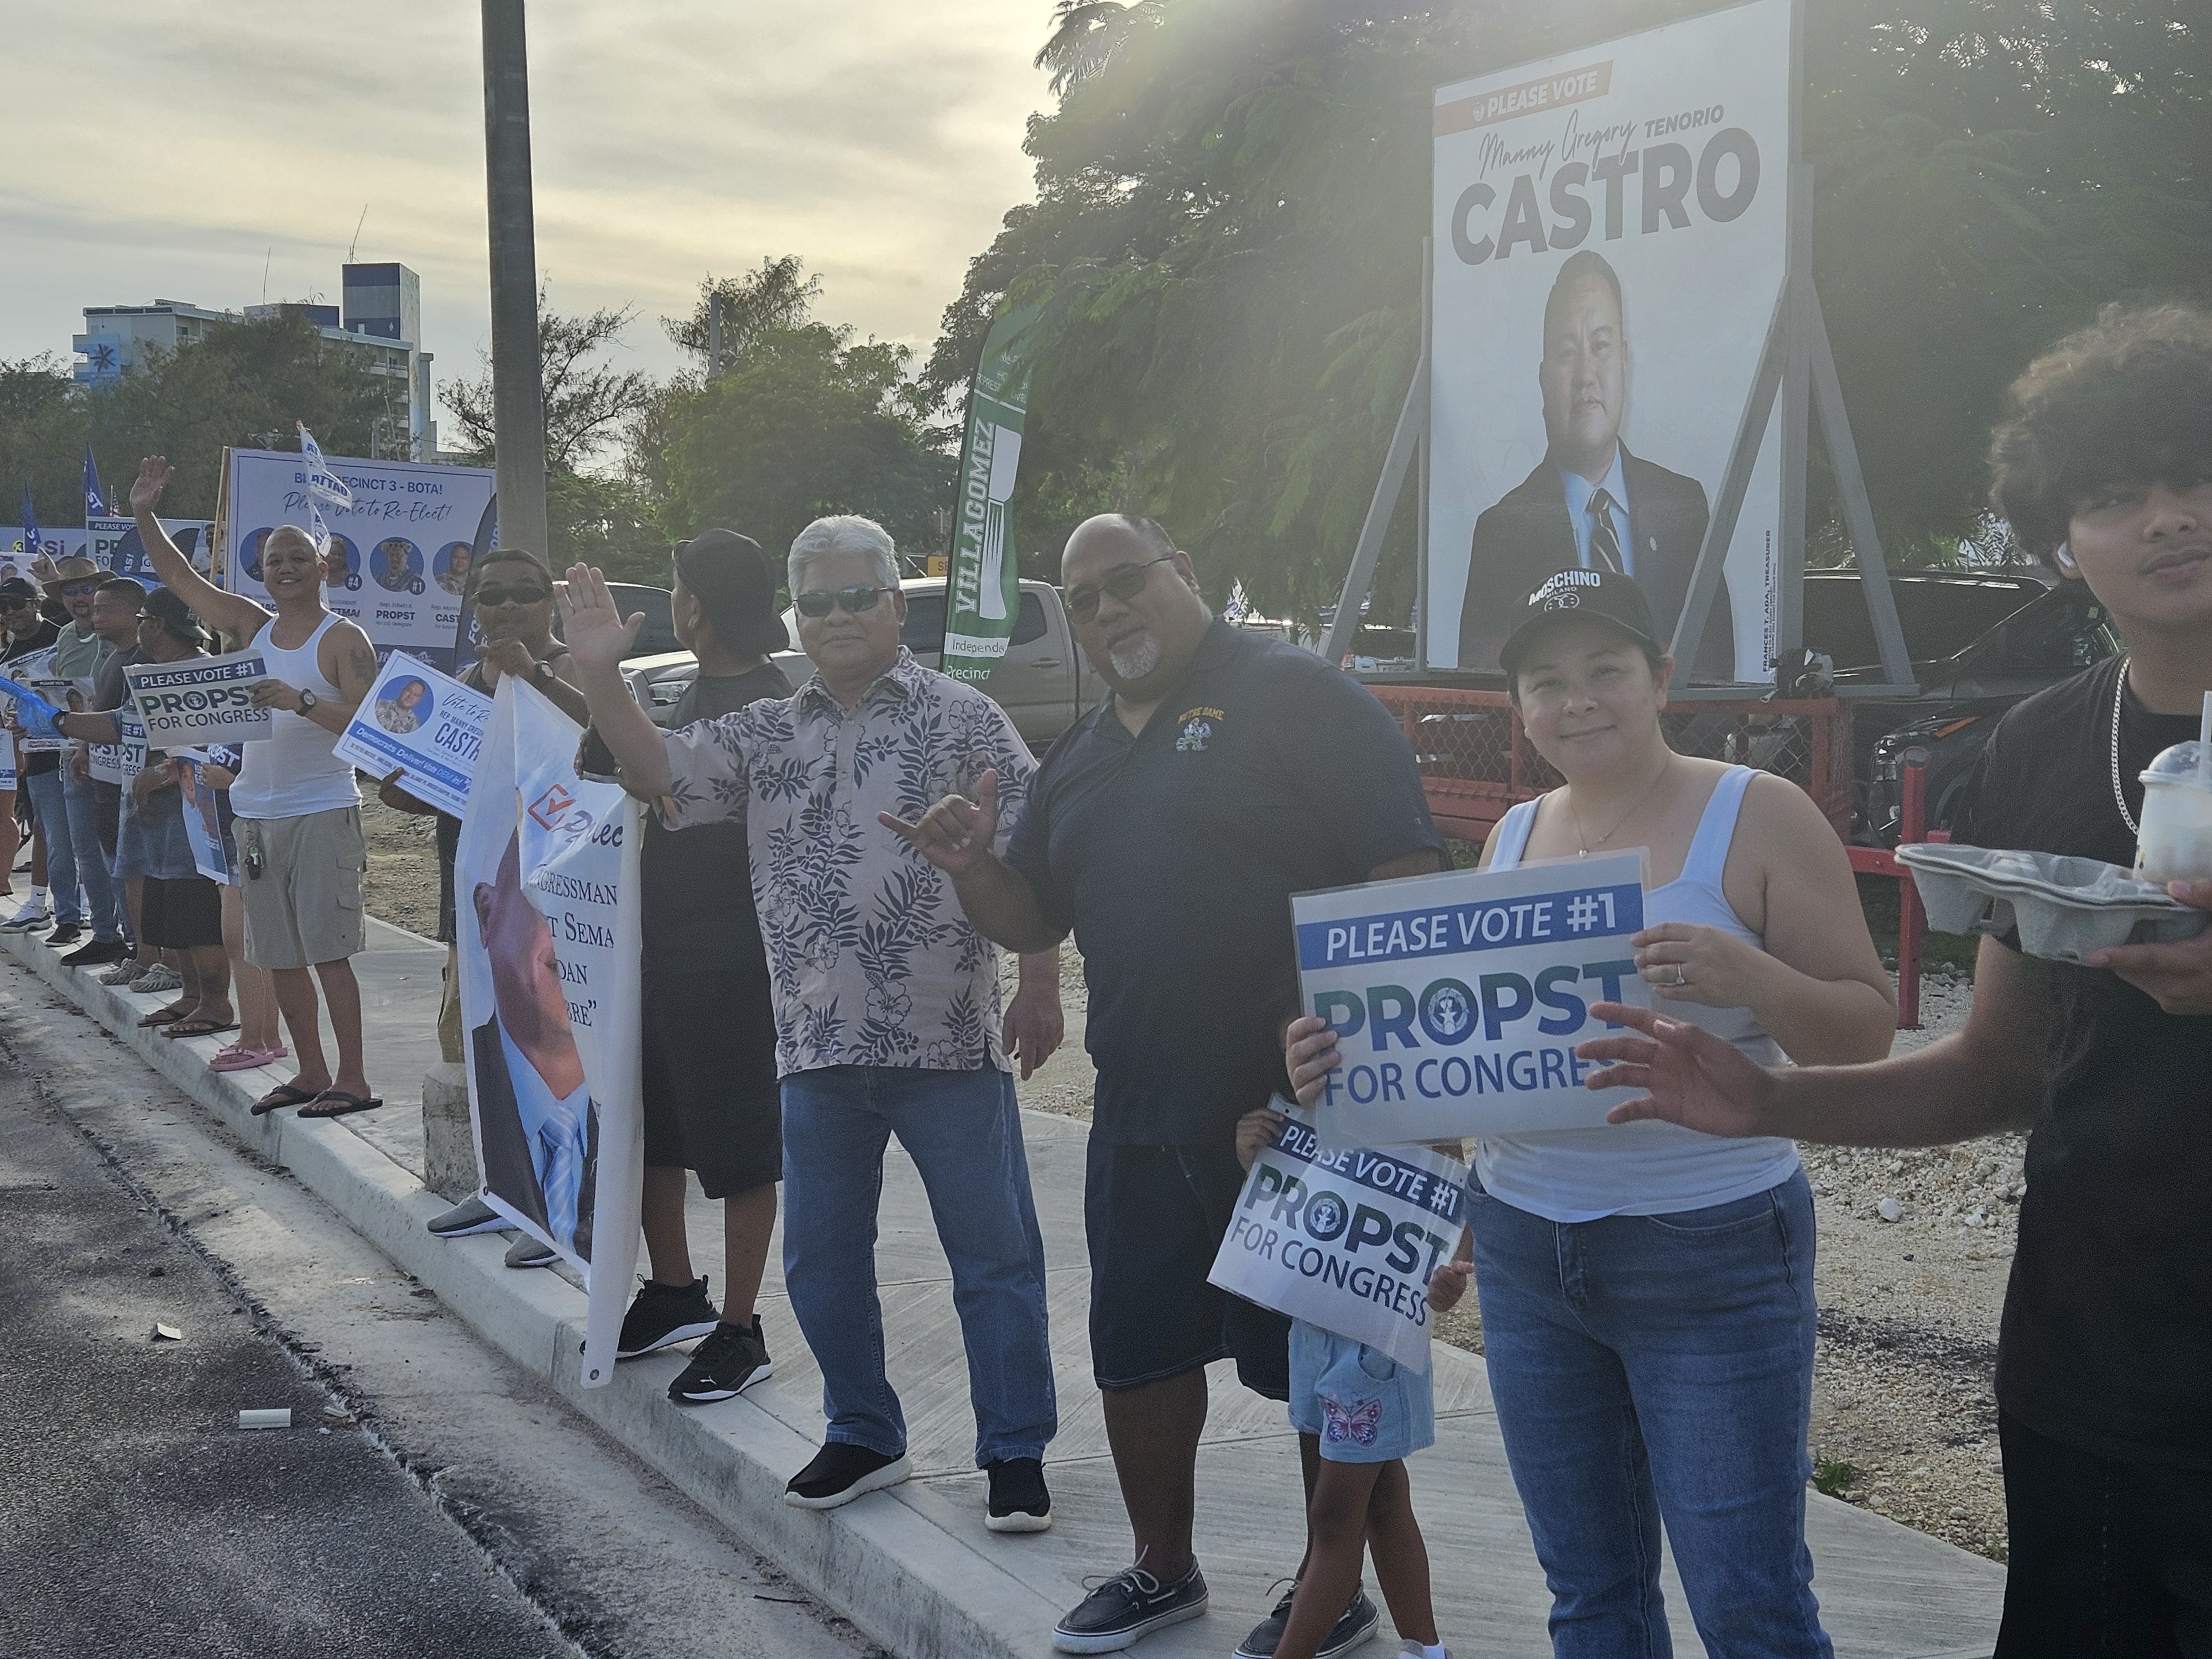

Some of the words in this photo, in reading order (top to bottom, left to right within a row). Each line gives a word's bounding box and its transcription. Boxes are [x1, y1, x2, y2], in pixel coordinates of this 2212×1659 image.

[1487, 84, 1549, 118] PLEASE
[1552, 70, 1599, 101] VOTE
[1479, 132, 1556, 181] Manny
[1561, 108, 1637, 173] Gregory
[1644, 104, 1725, 139] TENORIO
[1451, 127, 1761, 265] CASTRO
[389, 481, 397, 492] 3
[408, 483, 443, 495] BOTA!
[365, 498, 380, 517] to
[383, 500, 453, 522] Re-Elect!
[955, 418, 994, 614] VILLAGOMEZ
[348, 577, 359, 587] #4
[412, 581, 423, 592] #1
[1528, 571, 1601, 606] MOSCHINO
[1546, 586, 1577, 599] MILANO
[375, 609, 416, 620] PROPST
[1764, 615, 1769, 625] T.
[141, 672, 192, 688] PLEASE
[192, 667, 231, 682] VOTE
[236, 662, 256, 676] #1
[946, 665, 991, 680] Precinct
[139, 686, 252, 716] PROPS
[441, 692, 468, 711] Vote
[465, 703, 476, 716] to
[148, 716, 182, 732] FOR
[185, 708, 270, 728] CONGRESS
[439, 709, 451, 721] REP.
[452, 714, 470, 731] MANNY
[1178, 707, 1203, 724] NOTRE
[1202, 707, 1224, 722] DAME
[356, 727, 398, 754] Democrats
[395, 748, 424, 768] Deliver!
[422, 760, 438, 774] Vote
[1326, 914, 1448, 962] PLEASE
[1457, 901, 1553, 946] VOTE
[1567, 893, 1617, 933] #1
[1312, 958, 1639, 1053] PROPST
[1325, 1062, 1406, 1107] FOR
[1280, 1125, 1349, 1172] PLEASE
[1355, 1151, 1428, 1201] VOTE
[1430, 1181, 1459, 1216] #1
[1243, 1162, 1450, 1286] PROPST
[1229, 1216, 1279, 1260] FOR
[1281, 1240, 1428, 1327] CONGRESS
